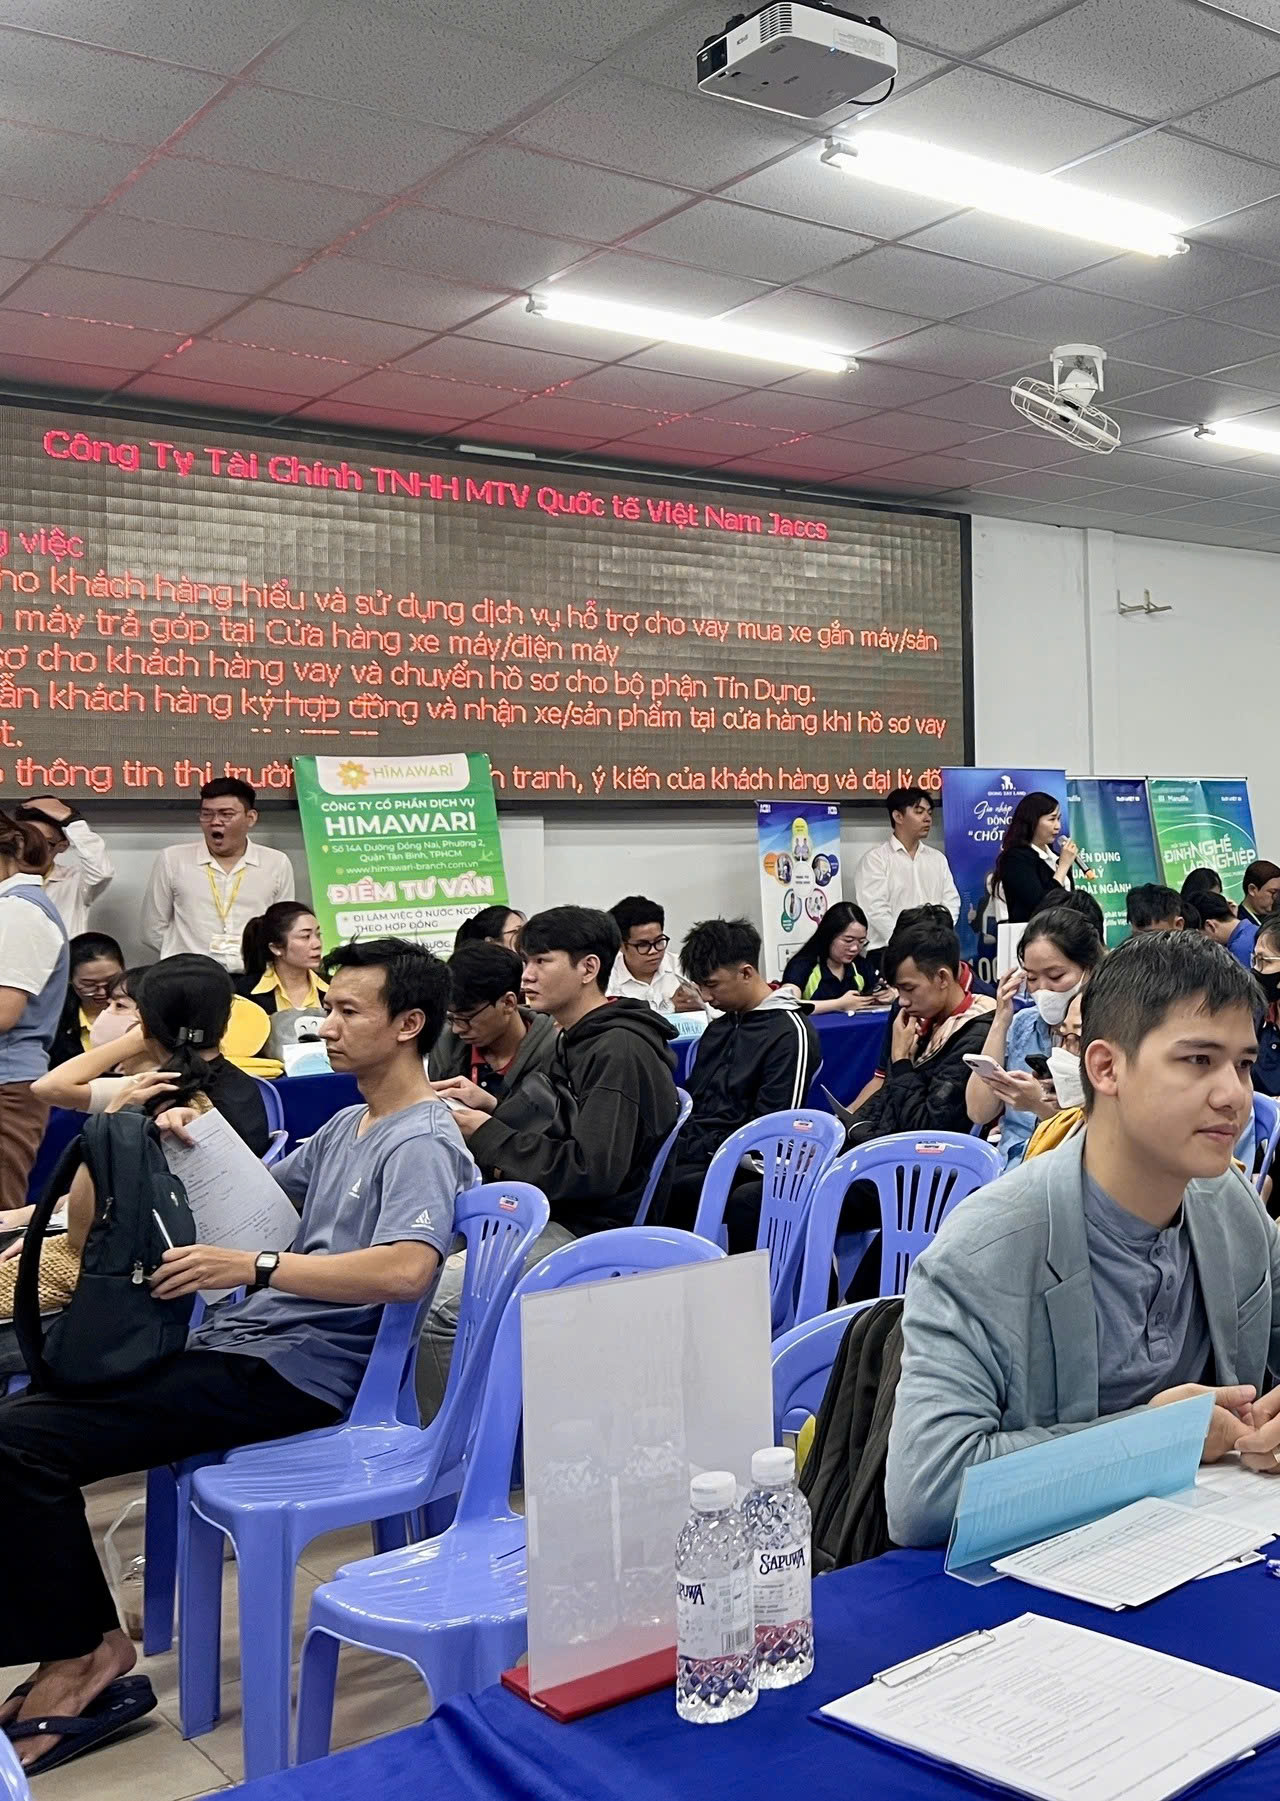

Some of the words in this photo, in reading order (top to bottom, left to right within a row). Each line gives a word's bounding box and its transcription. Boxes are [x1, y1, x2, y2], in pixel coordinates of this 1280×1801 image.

[43, 430, 140, 472] Công
[149, 441, 195, 477] Ty
[204, 448, 258, 479] Tài
[268, 456, 363, 491] Chính
[370, 467, 459, 501] TNHH
[466, 478, 530, 509] MTV
[537, 486, 605, 517] Quốc
[646, 498, 699, 530] Việt
[704, 505, 762, 533] Nam
[768, 512, 828, 541] Jaccs
[19, 527, 84, 563] việc
[50, 565, 146, 600] khách
[155, 573, 233, 611] hàng
[241, 578, 306, 611] hiểu
[314, 586, 348, 614] và
[355, 589, 392, 616] sử
[397, 591, 465, 627] dụng
[471, 598, 524, 628] dịch
[531, 607, 561, 632] vụ
[567, 599, 599, 630] hỗ
[605, 608, 640, 637] trợ
[644, 610, 686, 636] cho
[692, 619, 729, 643] vay
[737, 621, 783, 642] mua
[788, 625, 812, 643] xe
[818, 619, 855, 649] gắn
[860, 627, 938, 654] máy/sản
[14, 604, 86, 639] máy
[96, 608, 141, 637] trả
[150, 611, 210, 645] góp
[219, 616, 256, 647] tại
[266, 618, 324, 647] Cửa
[332, 620, 402, 656] hàng
[408, 632, 440, 653] xe
[449, 630, 563, 663] máy/điện
[572, 638, 620, 667] máy
[37, 642, 97, 672] cho
[106, 644, 199, 677] khách
[208, 649, 285, 686] hàng
[293, 661, 342, 688] vay
[350, 660, 383, 685] và
[390, 659, 483, 691] chuyển
[490, 664, 523, 690] hồ
[530, 671, 560, 692] sơ
[565, 669, 608, 694] cho
[614, 670, 645, 700] bộ
[651, 673, 707, 702] phận
[713, 676, 748, 700] Tín
[754, 678, 816, 706] Dụng.
[50, 680, 145, 712] khách
[154, 684, 232, 720] hàng
[241, 688, 276, 721] ký
[285, 689, 341, 722] hợp
[349, 692, 419, 726] đồng
[427, 695, 457, 720] và
[464, 696, 527, 728] nhận
[534, 700, 612, 729] xe/sản
[618, 700, 682, 731] phẩm
[690, 706, 715, 733] tại
[722, 707, 761, 730] cửa
[766, 707, 818, 736] hàng
[823, 709, 852, 732] khi
[857, 710, 883, 733] hồ
[888, 715, 912, 733] sơ
[915, 718, 947, 739] vay
[15, 756, 113, 793] thông
[122, 760, 164, 788] tin
[512, 764, 583, 794] tranh,
[591, 764, 606, 794] ý
[612, 765, 661, 790] kiến
[666, 766, 706, 790] của
[710, 766, 773, 790] khách
[778, 767, 830, 795] hàng
[834, 768, 858, 790] và
[862, 768, 891, 794] đại
[321, 800, 356, 812] CÔNG
[358, 801, 373, 811] TY
[430, 798, 457, 810] DỊCH
[459, 798, 475, 809] VỤ
[325, 811, 477, 836] HIMAWARI
[430, 850, 463, 858] TPHCM
[1094, 851, 1121, 865] DỤNG
[328, 876, 397, 904] ĐIỂM
[399, 876, 437, 900] TƯ
[438, 871, 494, 898] VẤN
[355, 924, 382, 933] THEO
[392, 910, 413, 920] VIỆC
[759, 1548, 806, 1576] SAPUWA
